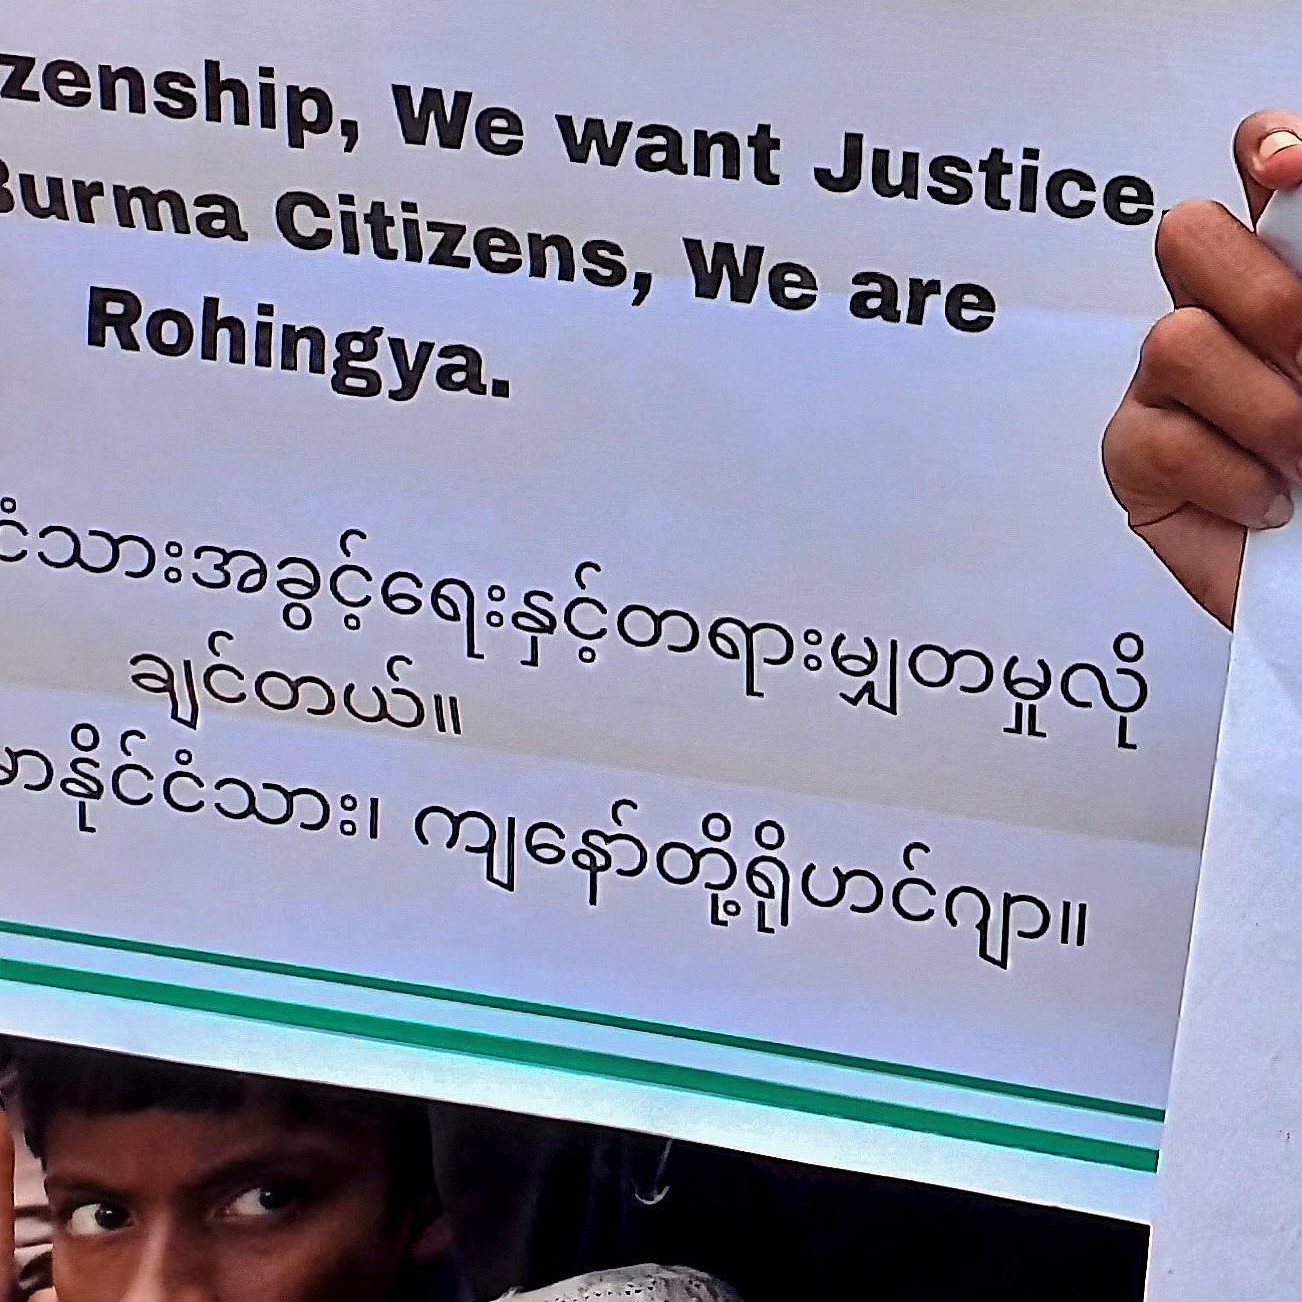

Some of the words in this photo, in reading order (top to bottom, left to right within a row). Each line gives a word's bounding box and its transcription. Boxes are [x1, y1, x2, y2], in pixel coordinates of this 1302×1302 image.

[0, 53, 360, 154] zenship,
[391, 83, 525, 157] We
[554, 113, 782, 186] want
[813, 131, 1168, 226] Justice
[275, 190, 654, 309] Citizens,
[682, 236, 819, 311] We
[849, 271, 997, 333] are
[87, 285, 511, 402] Rohingya.
